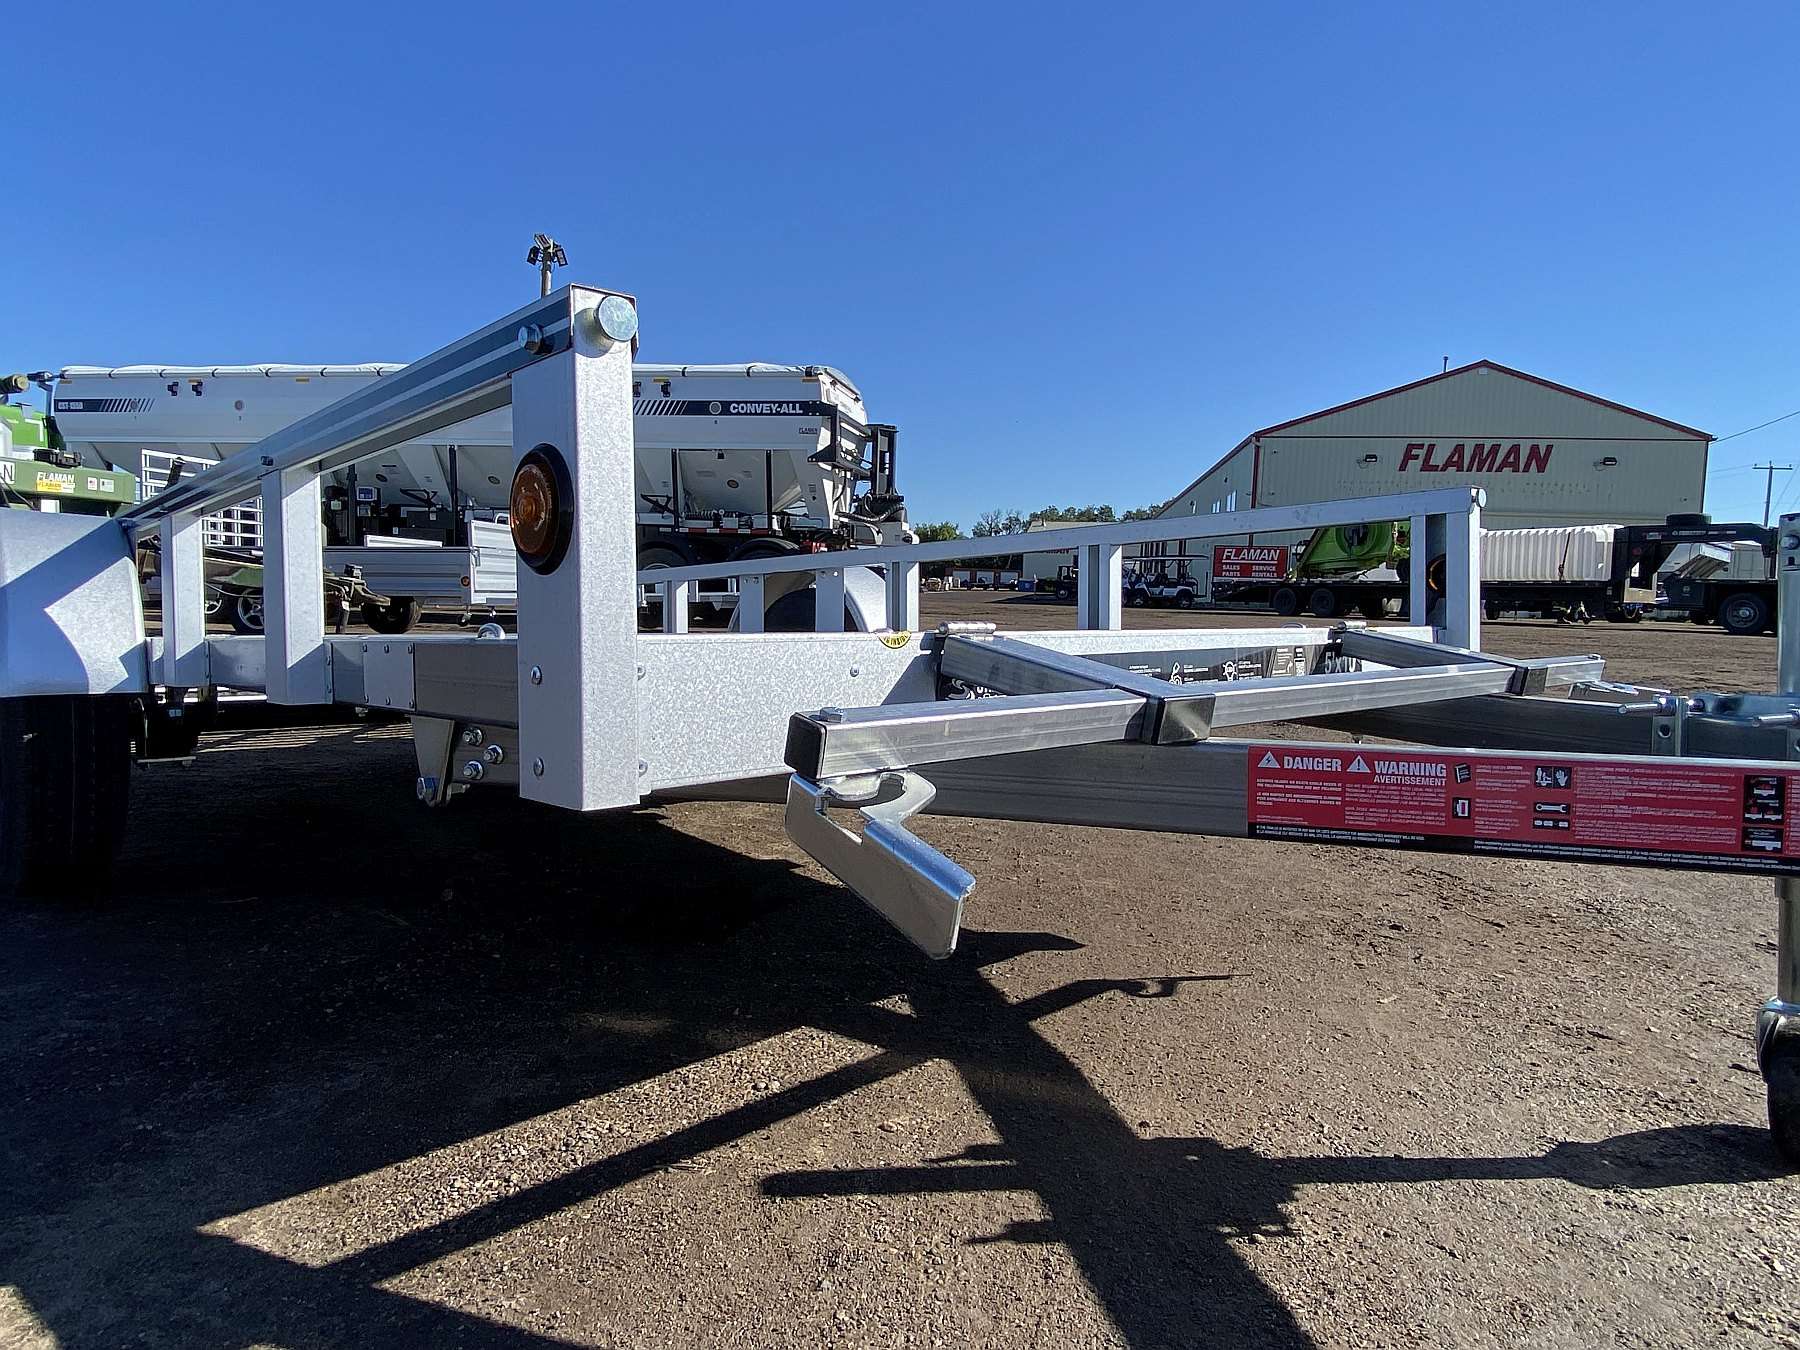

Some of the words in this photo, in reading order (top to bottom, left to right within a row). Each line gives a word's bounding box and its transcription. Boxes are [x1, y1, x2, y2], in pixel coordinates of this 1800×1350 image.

[729, 403, 803, 414] CONVEY-ALL
[1398, 443, 1554, 473] FLAMAN
[36, 472, 75, 484] FLAMAN
[1223, 548, 1280, 561] FLAMAN
[1283, 755, 1342, 772] DANGER
[1374, 760, 1447, 777] WARNING
[1373, 774, 1447, 786] AVERTISSEMENT
